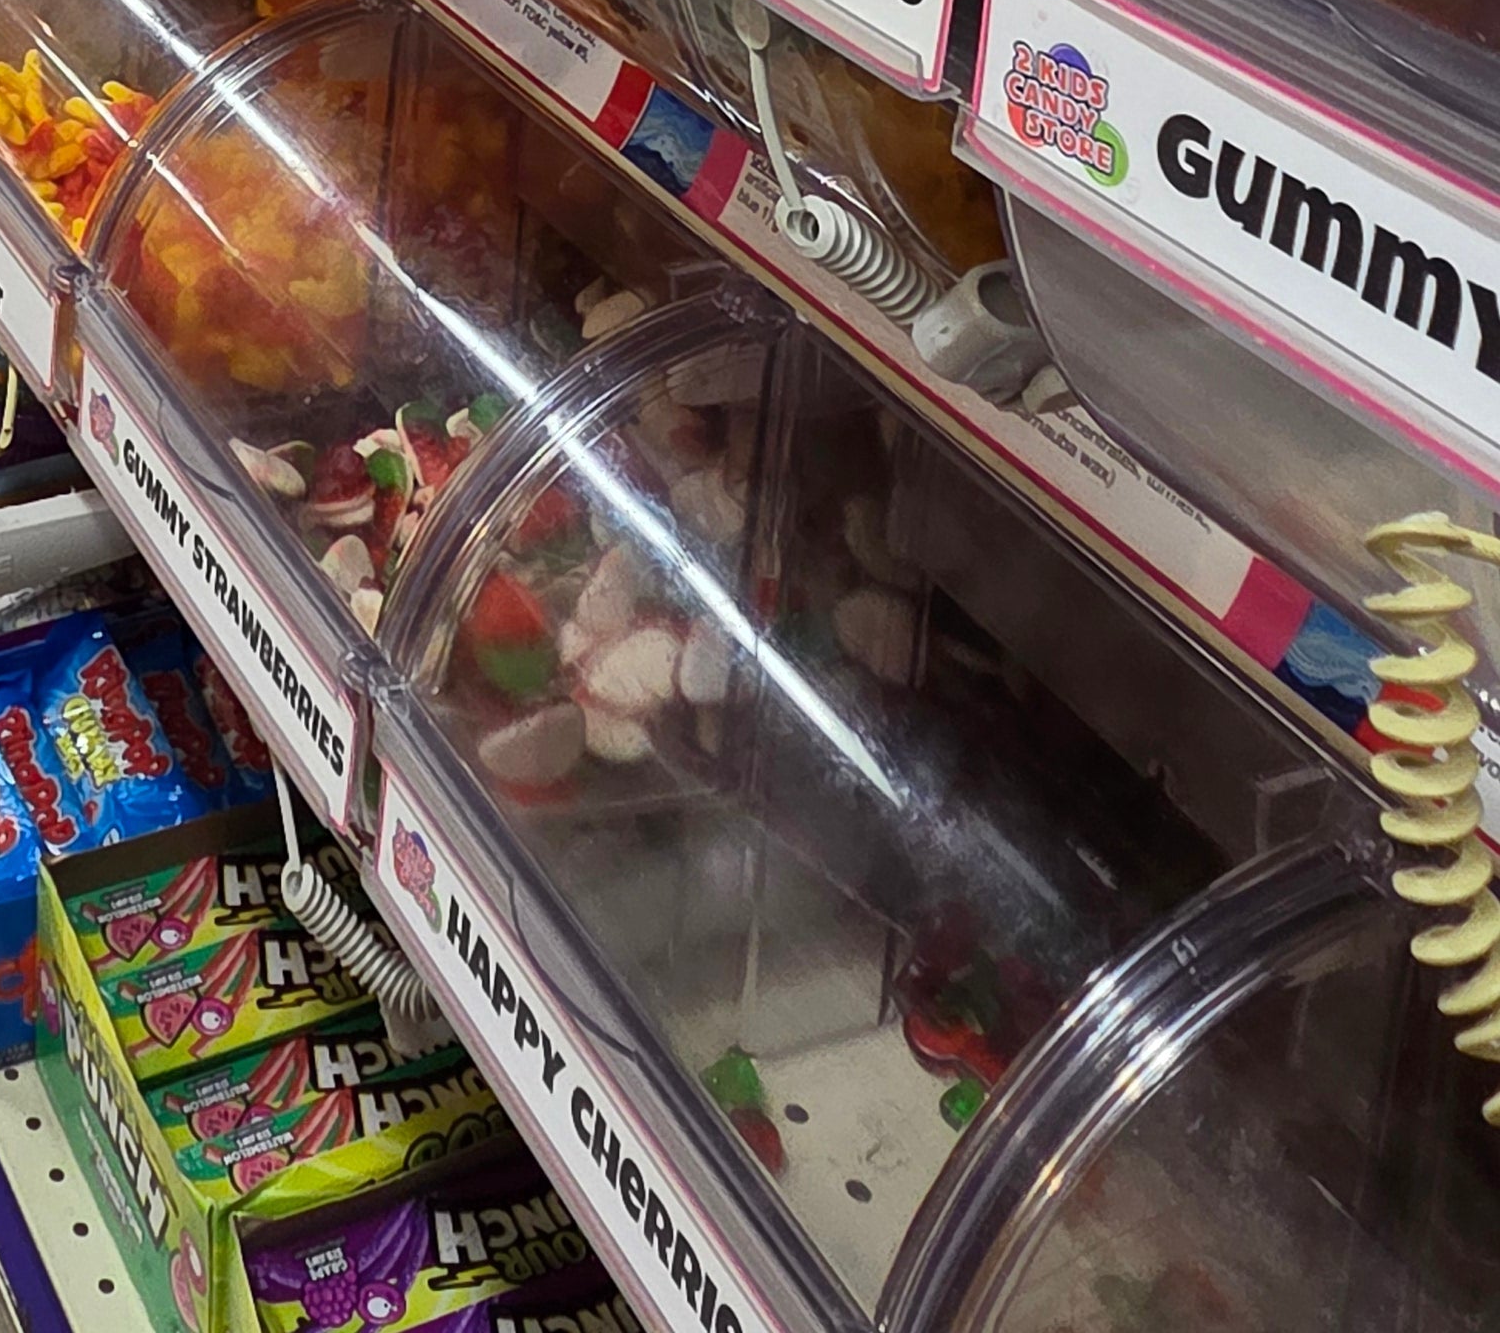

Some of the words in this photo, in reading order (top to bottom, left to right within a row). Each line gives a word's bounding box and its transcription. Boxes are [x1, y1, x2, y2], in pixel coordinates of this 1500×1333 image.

[1005, 70, 1100, 136] CANDY
[1013, 40, 1033, 74] 2
[1037, 51, 1109, 111] KIDS
[1024, 109, 1115, 176] STORE
[124, 439, 188, 546] GUMMY
[191, 520, 348, 778] STRAWBERRIES
[447, 896, 565, 1092] HAPPY
